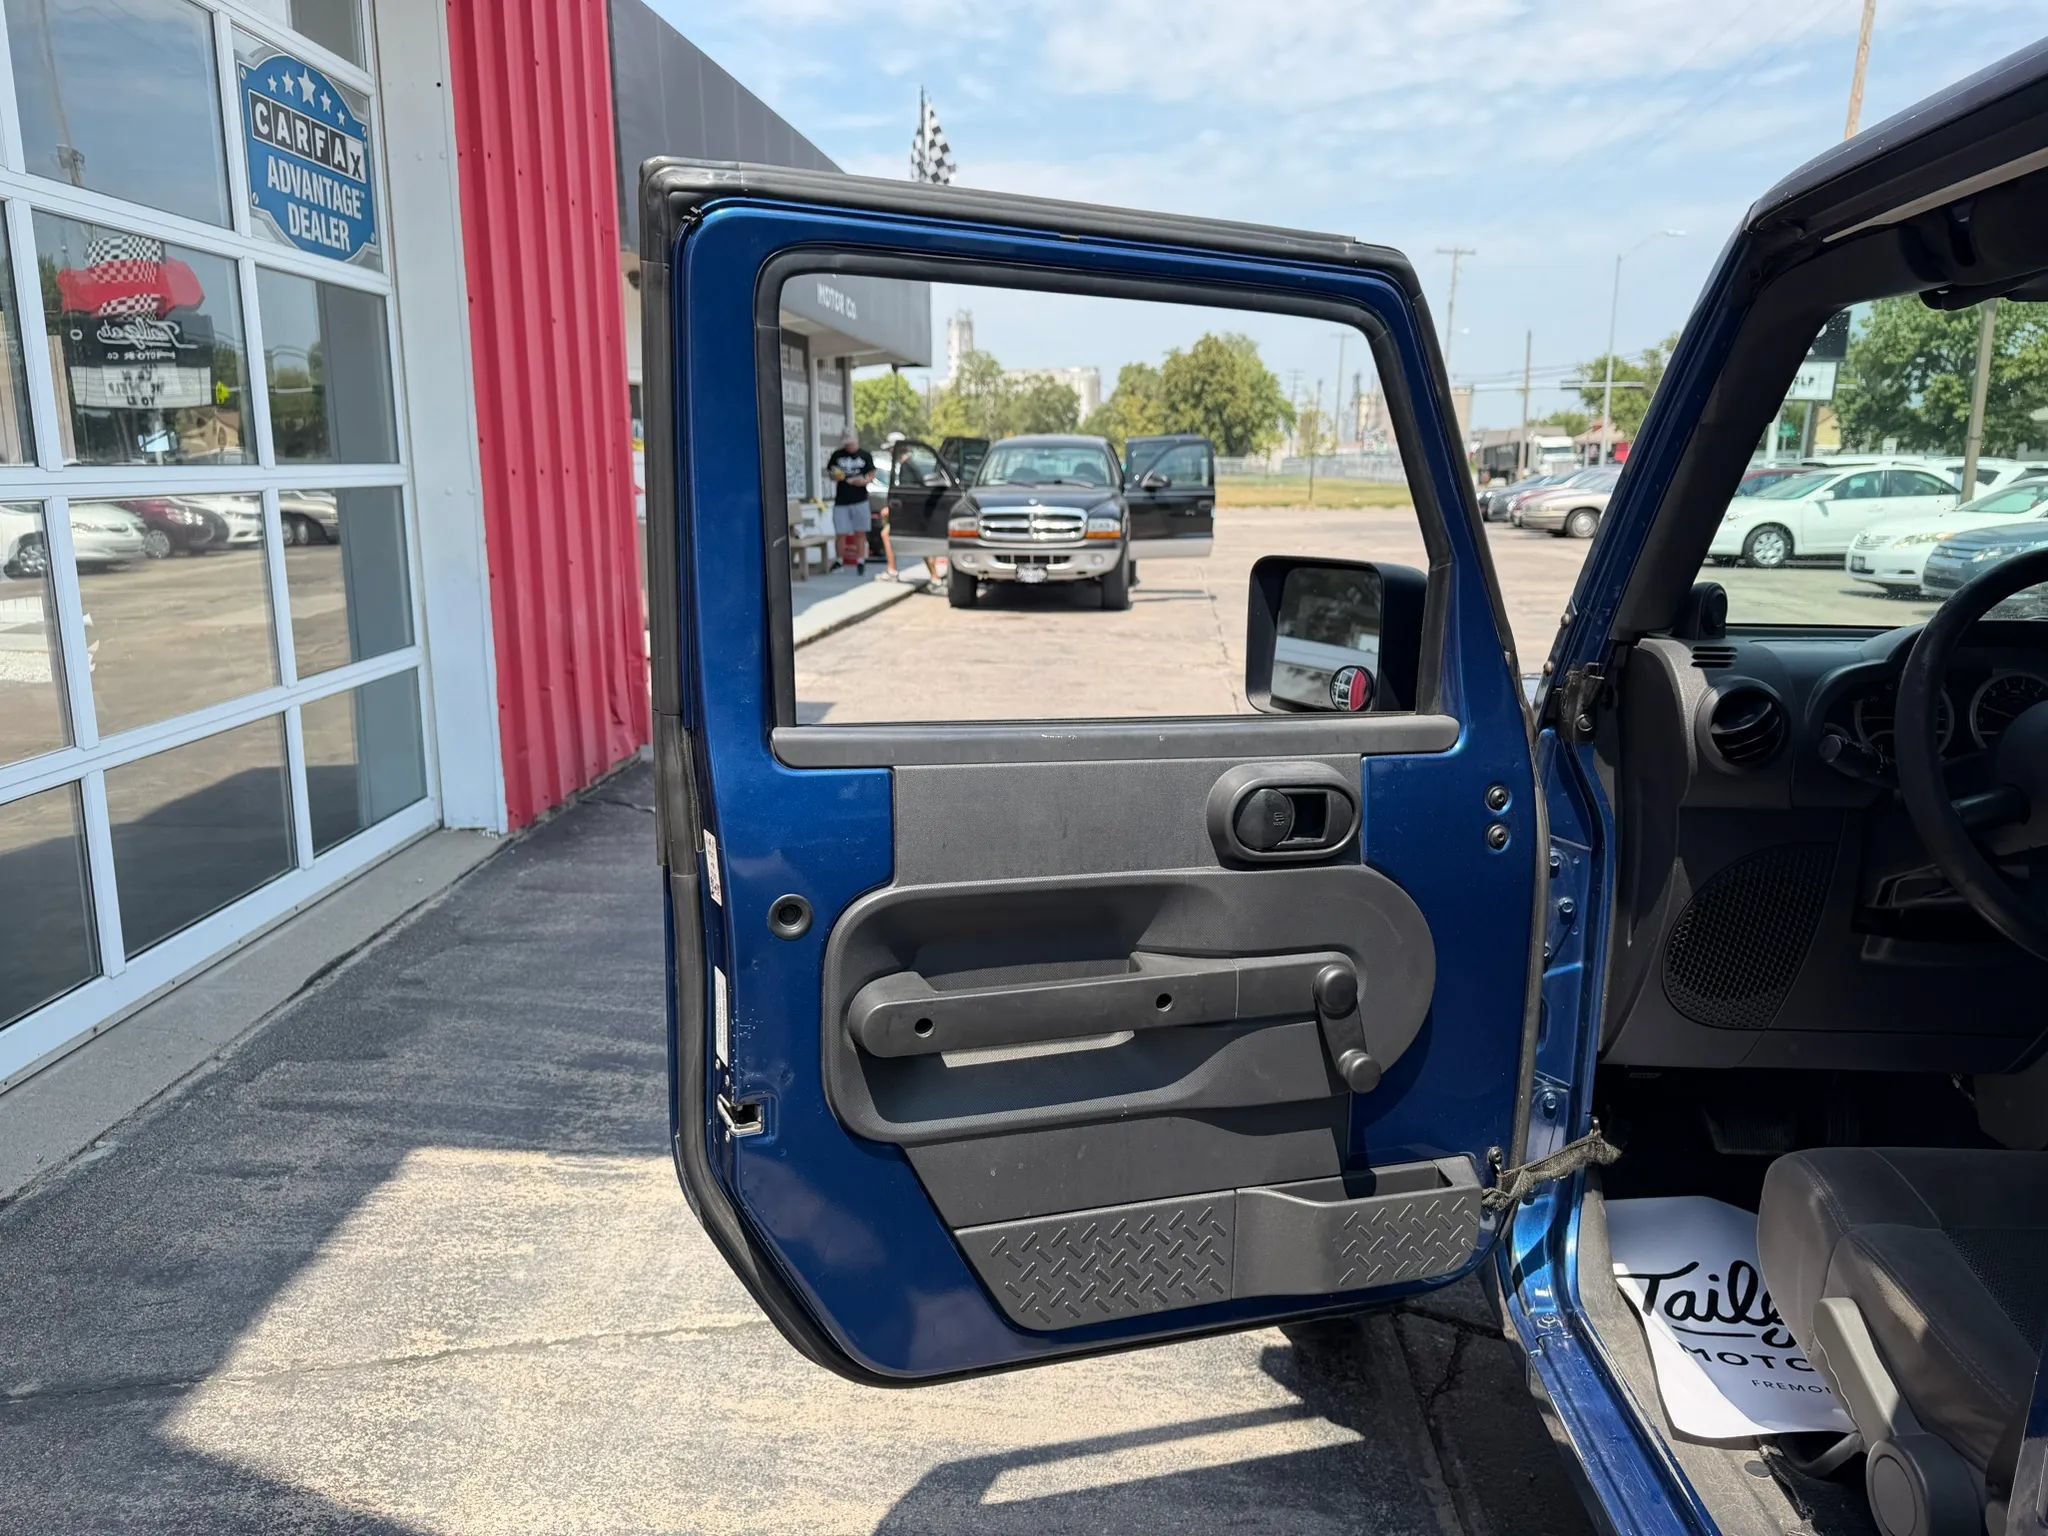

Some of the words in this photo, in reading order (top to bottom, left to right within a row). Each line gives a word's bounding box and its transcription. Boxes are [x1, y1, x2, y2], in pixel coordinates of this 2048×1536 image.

[254, 101, 363, 180] CARFAX
[287, 201, 351, 252] DEALER
[816, 281, 845, 316] MOTOR
